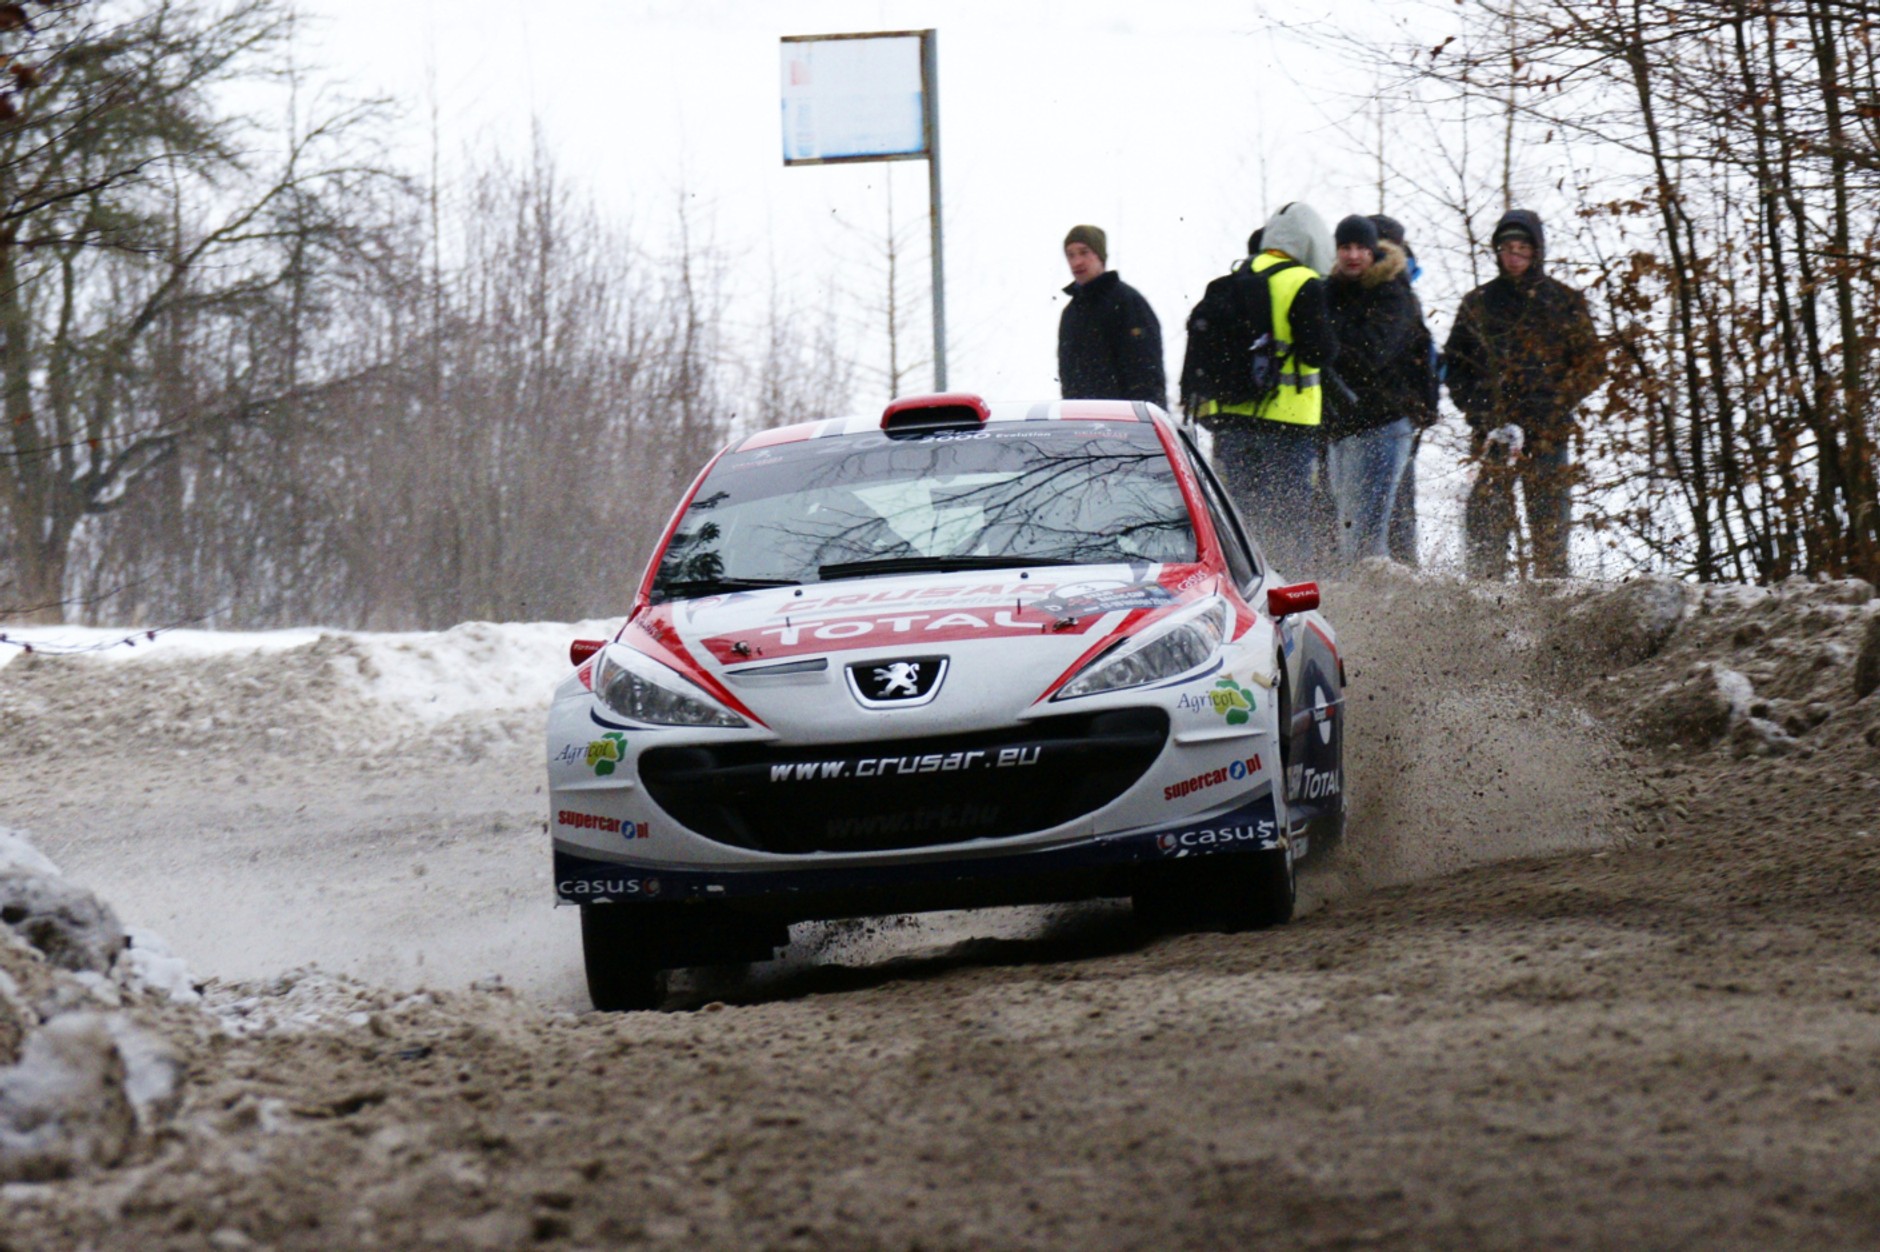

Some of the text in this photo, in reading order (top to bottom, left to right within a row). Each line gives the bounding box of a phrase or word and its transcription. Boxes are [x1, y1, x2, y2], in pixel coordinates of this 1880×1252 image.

[775, 583, 1057, 614] CRUSAR
[760, 610, 1044, 646] TOTAL
[1303, 767, 1340, 799] TOTAL
[558, 879, 640, 894] casus
